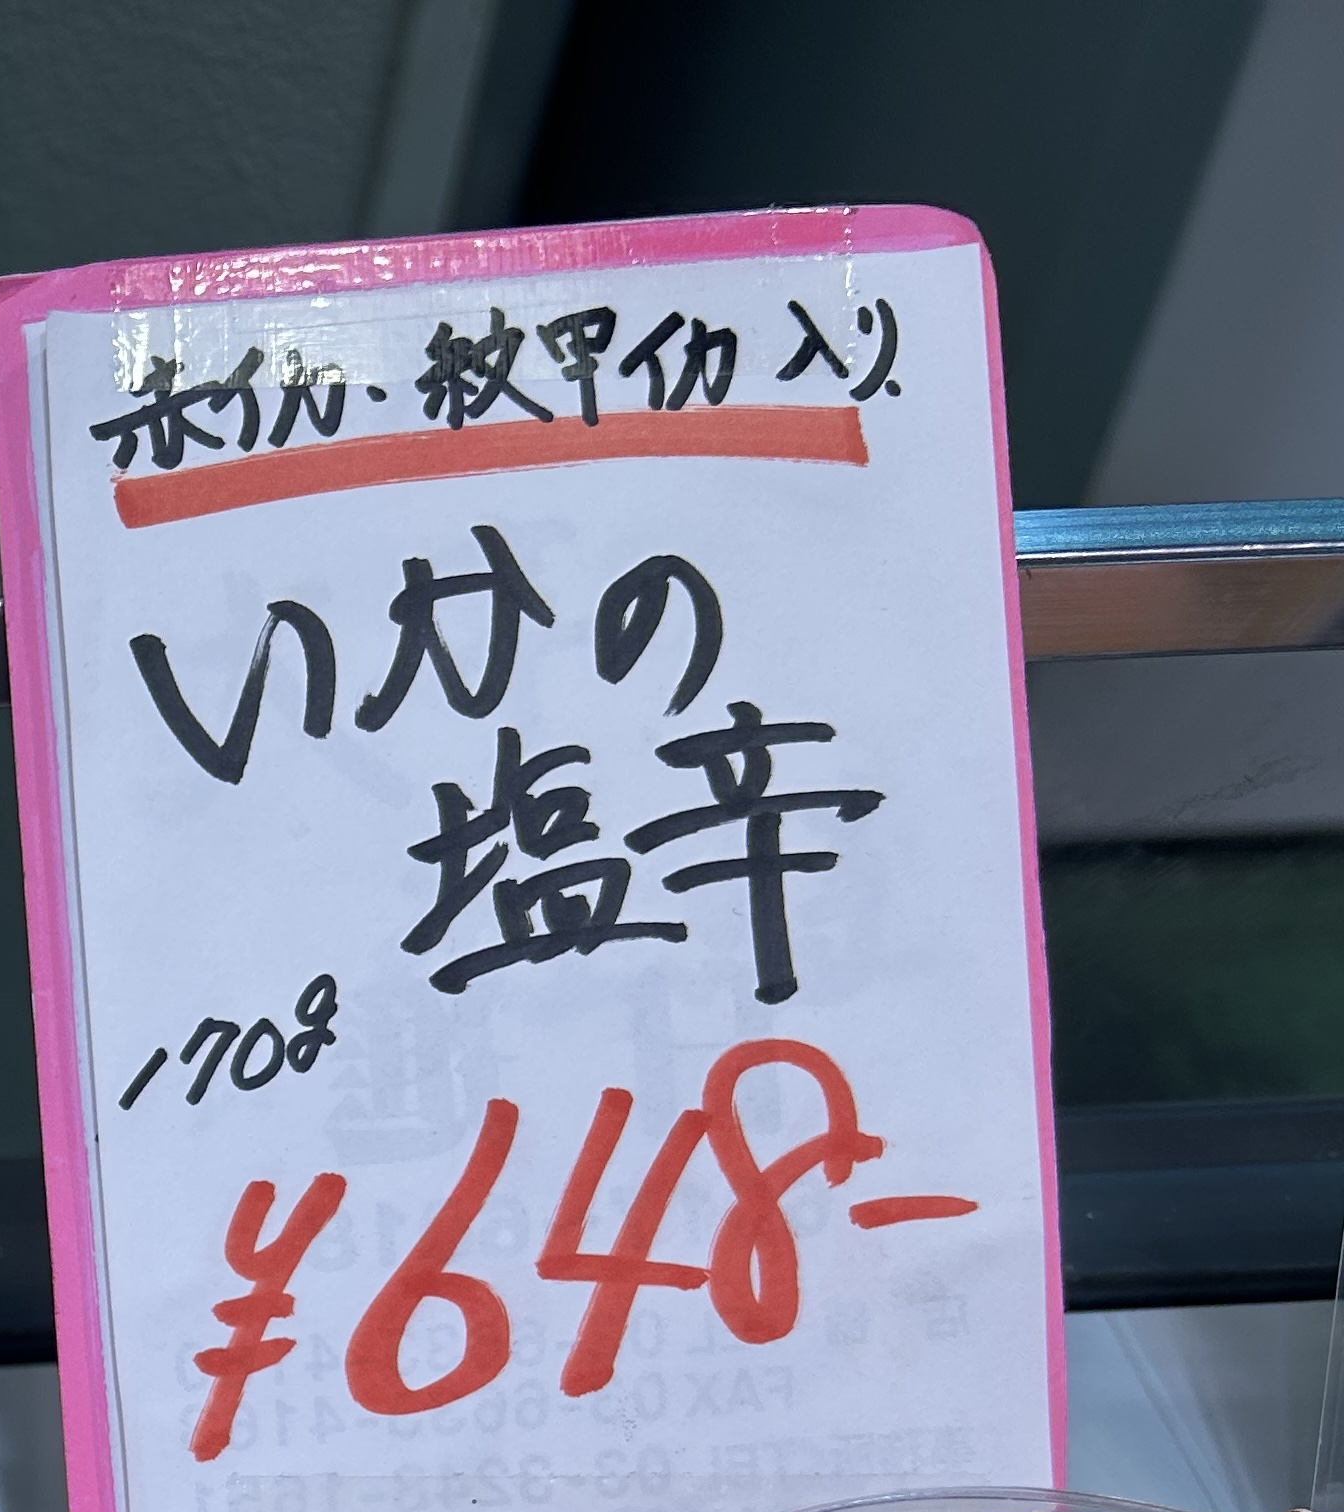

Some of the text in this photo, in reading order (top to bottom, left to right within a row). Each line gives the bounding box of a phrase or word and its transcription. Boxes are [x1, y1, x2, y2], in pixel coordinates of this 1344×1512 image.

[128, 522, 725, 786] いかの
[400, 700, 887, 1006] 塩辛
